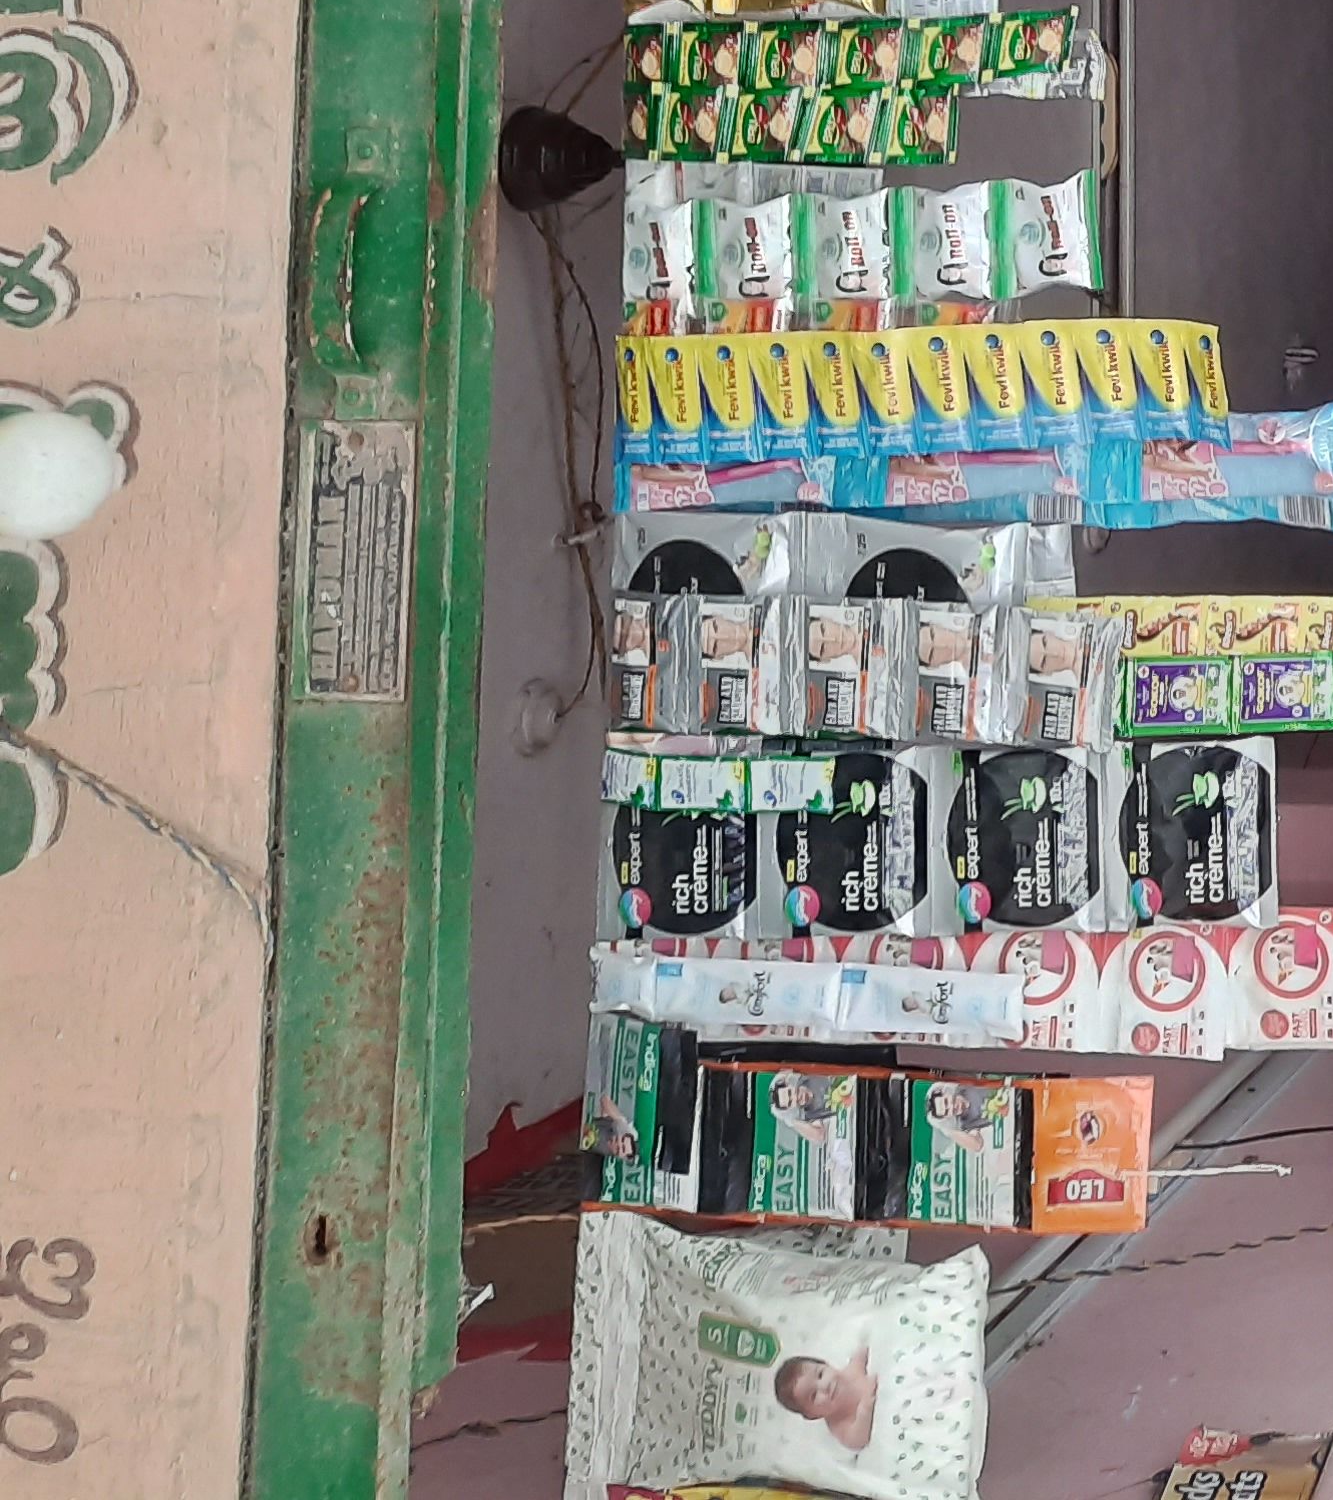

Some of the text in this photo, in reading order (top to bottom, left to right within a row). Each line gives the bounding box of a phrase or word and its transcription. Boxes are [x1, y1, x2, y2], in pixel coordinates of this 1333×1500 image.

[795, 828, 811, 882] expert
[1135, 820, 1151, 875] expert
[1204, 832, 1225, 904] crème
[842, 871, 860, 912] rich
[860, 842, 879, 912] crème
[1186, 862, 1204, 904] rich
[932, 1152, 955, 1220] EASY
[1063, 1177, 1107, 1201] LEO
